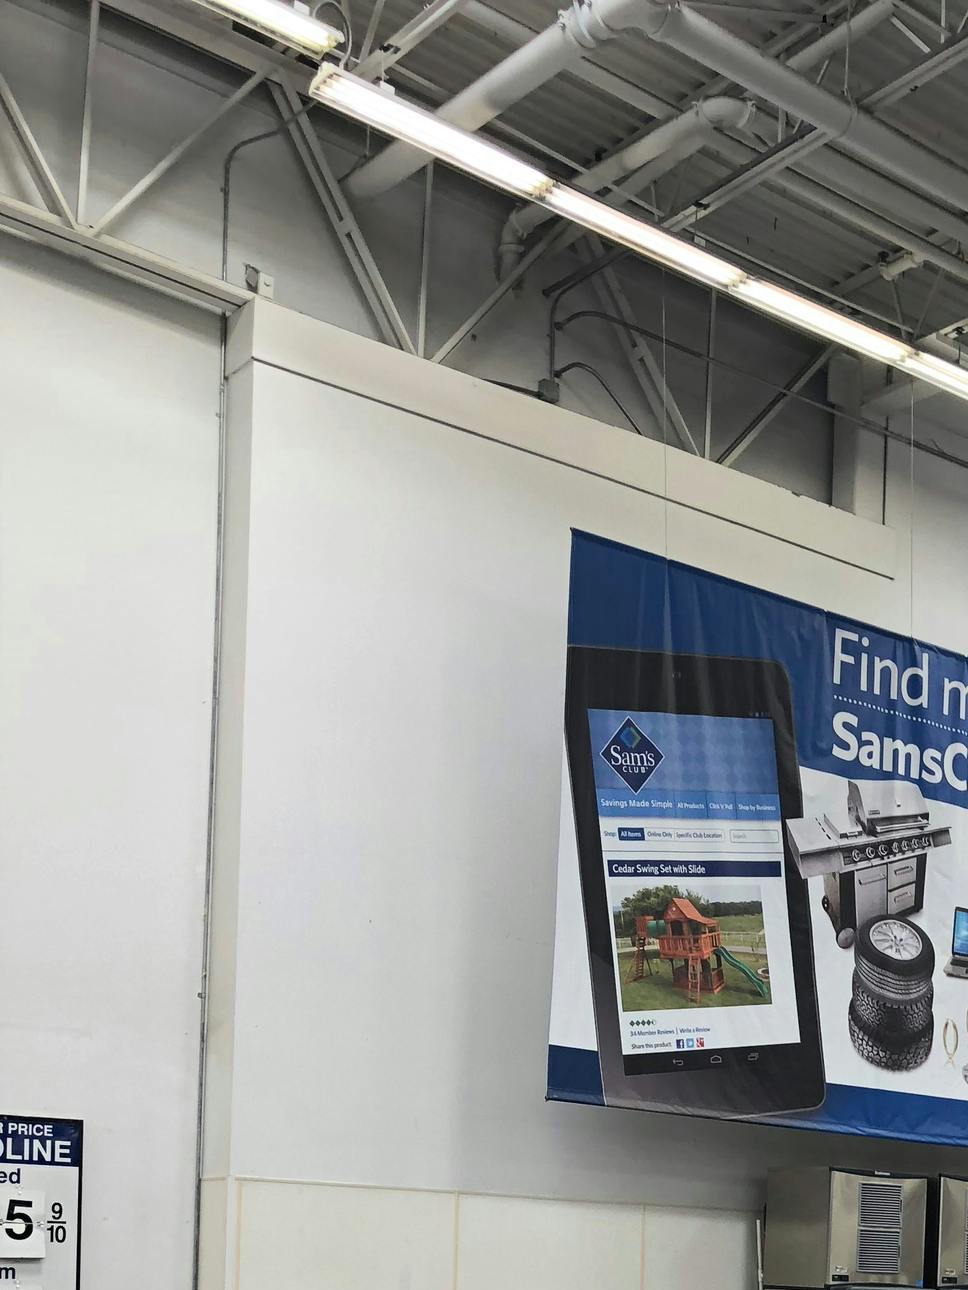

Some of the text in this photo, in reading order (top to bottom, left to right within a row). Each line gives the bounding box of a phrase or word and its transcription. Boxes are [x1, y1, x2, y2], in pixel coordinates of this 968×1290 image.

[832, 628, 929, 708] Find
[610, 745, 655, 767] Sam's
[600, 799, 673, 809] Savings Made Simple
[612, 864, 706, 875] Cedar Swing Set with Slide
[8, 1122, 54, 1137] PRICE
[0, 1138, 72, 1163] LINE
[5, 1199, 33, 1241] 5
